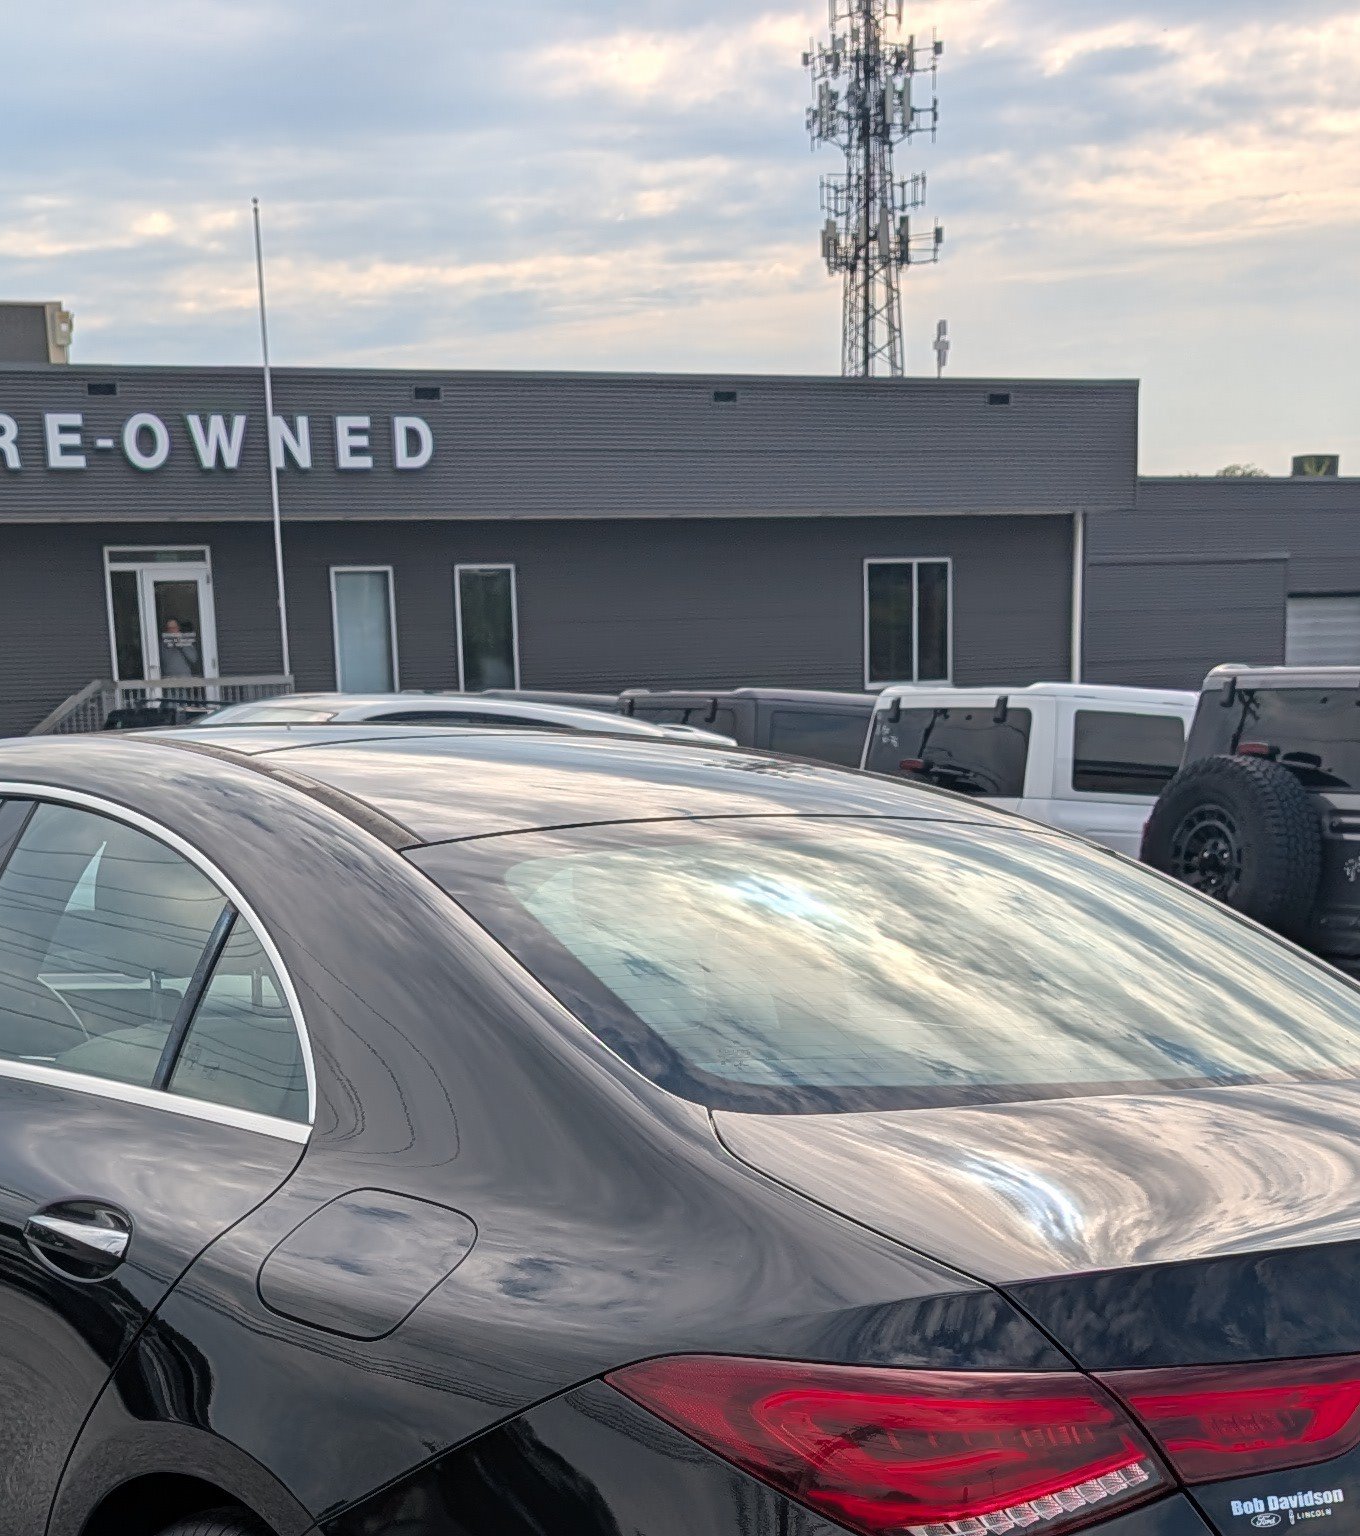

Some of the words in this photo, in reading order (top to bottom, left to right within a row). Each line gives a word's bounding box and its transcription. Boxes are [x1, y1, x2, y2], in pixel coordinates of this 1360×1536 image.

[1231, 1498, 1265, 1516] Bob
[1267, 1489, 1344, 1512] Davidson
[1296, 1508, 1332, 1520] LINCOLN
